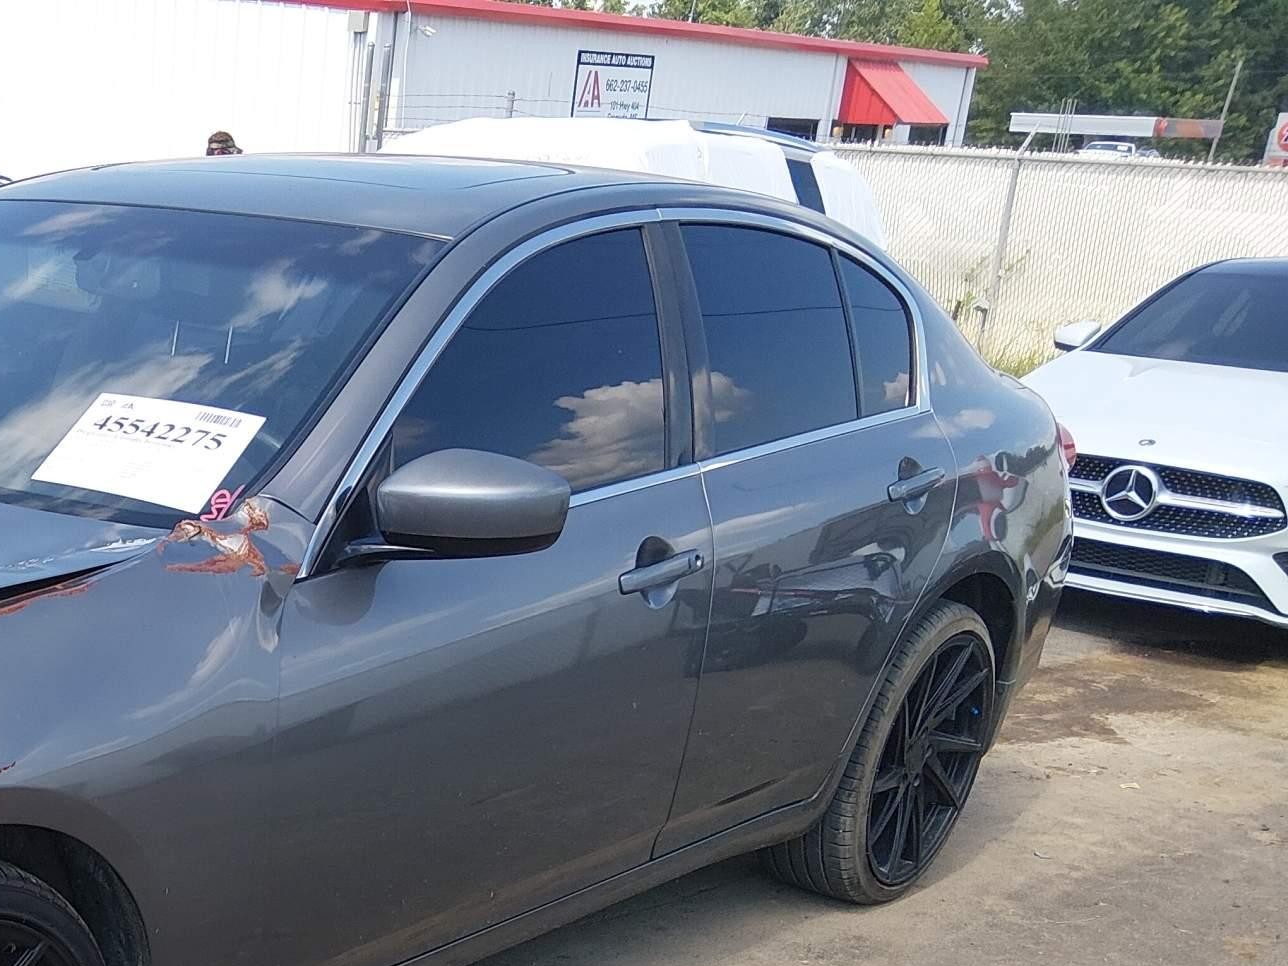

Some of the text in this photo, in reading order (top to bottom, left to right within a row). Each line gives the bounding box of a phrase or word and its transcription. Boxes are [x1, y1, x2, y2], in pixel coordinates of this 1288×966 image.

[580, 52, 652, 67] INSURANCE AUTO AUCTIONS
[94, 415, 227, 450] 45542275
